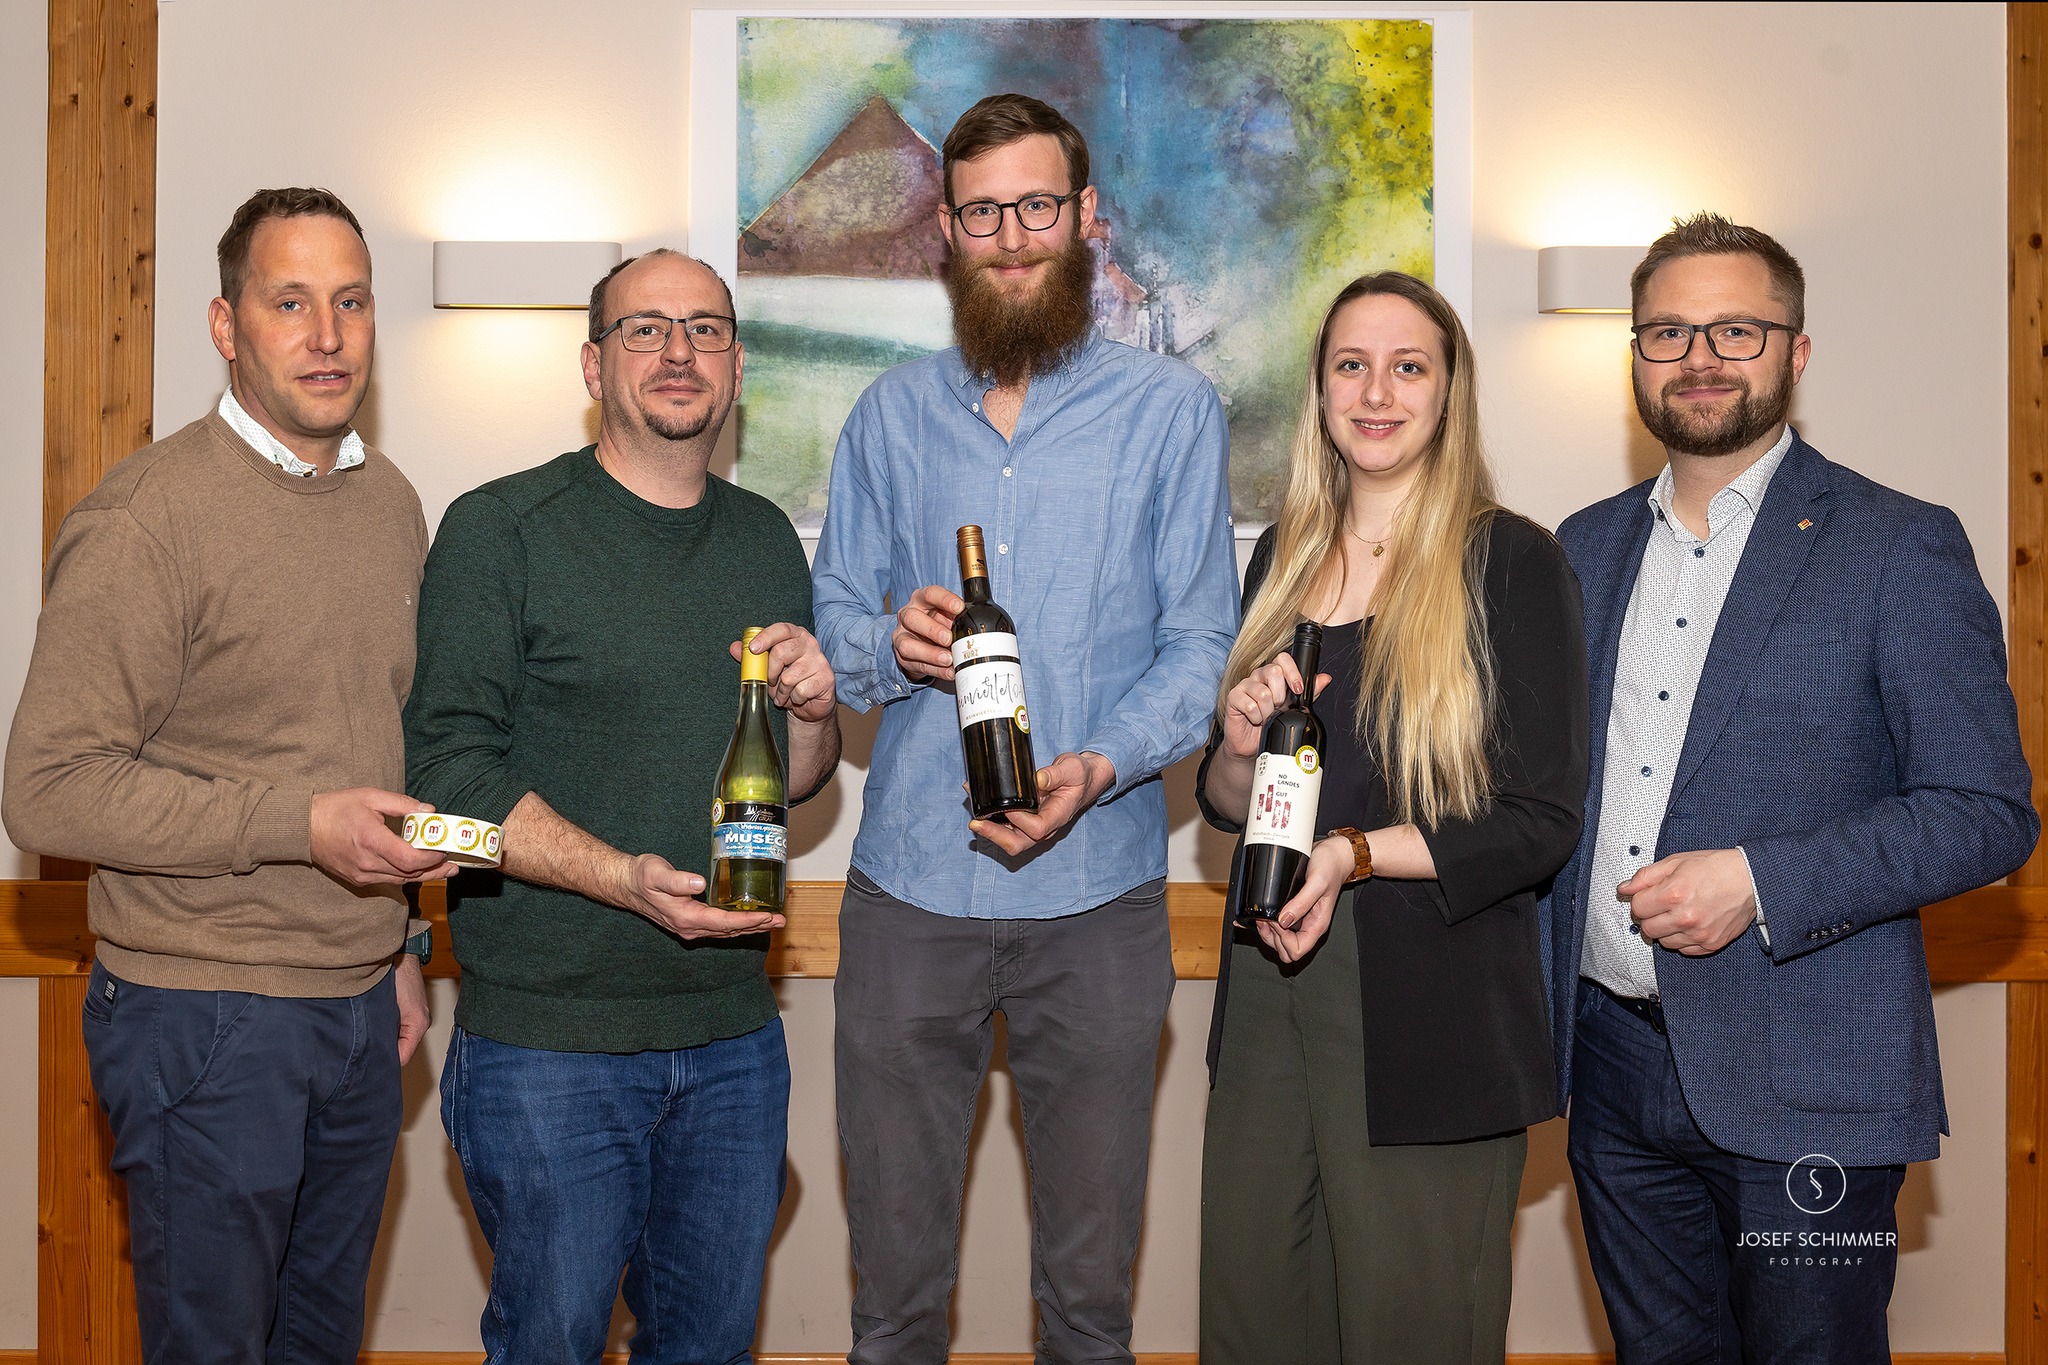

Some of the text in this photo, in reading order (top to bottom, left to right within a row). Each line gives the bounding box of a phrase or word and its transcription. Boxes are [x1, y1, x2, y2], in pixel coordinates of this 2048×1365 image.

[964, 649, 979, 660] KURZ
[1277, 780, 1300, 789] LANDES
[428, 825, 439, 835] m
[461, 829, 472, 839] m
